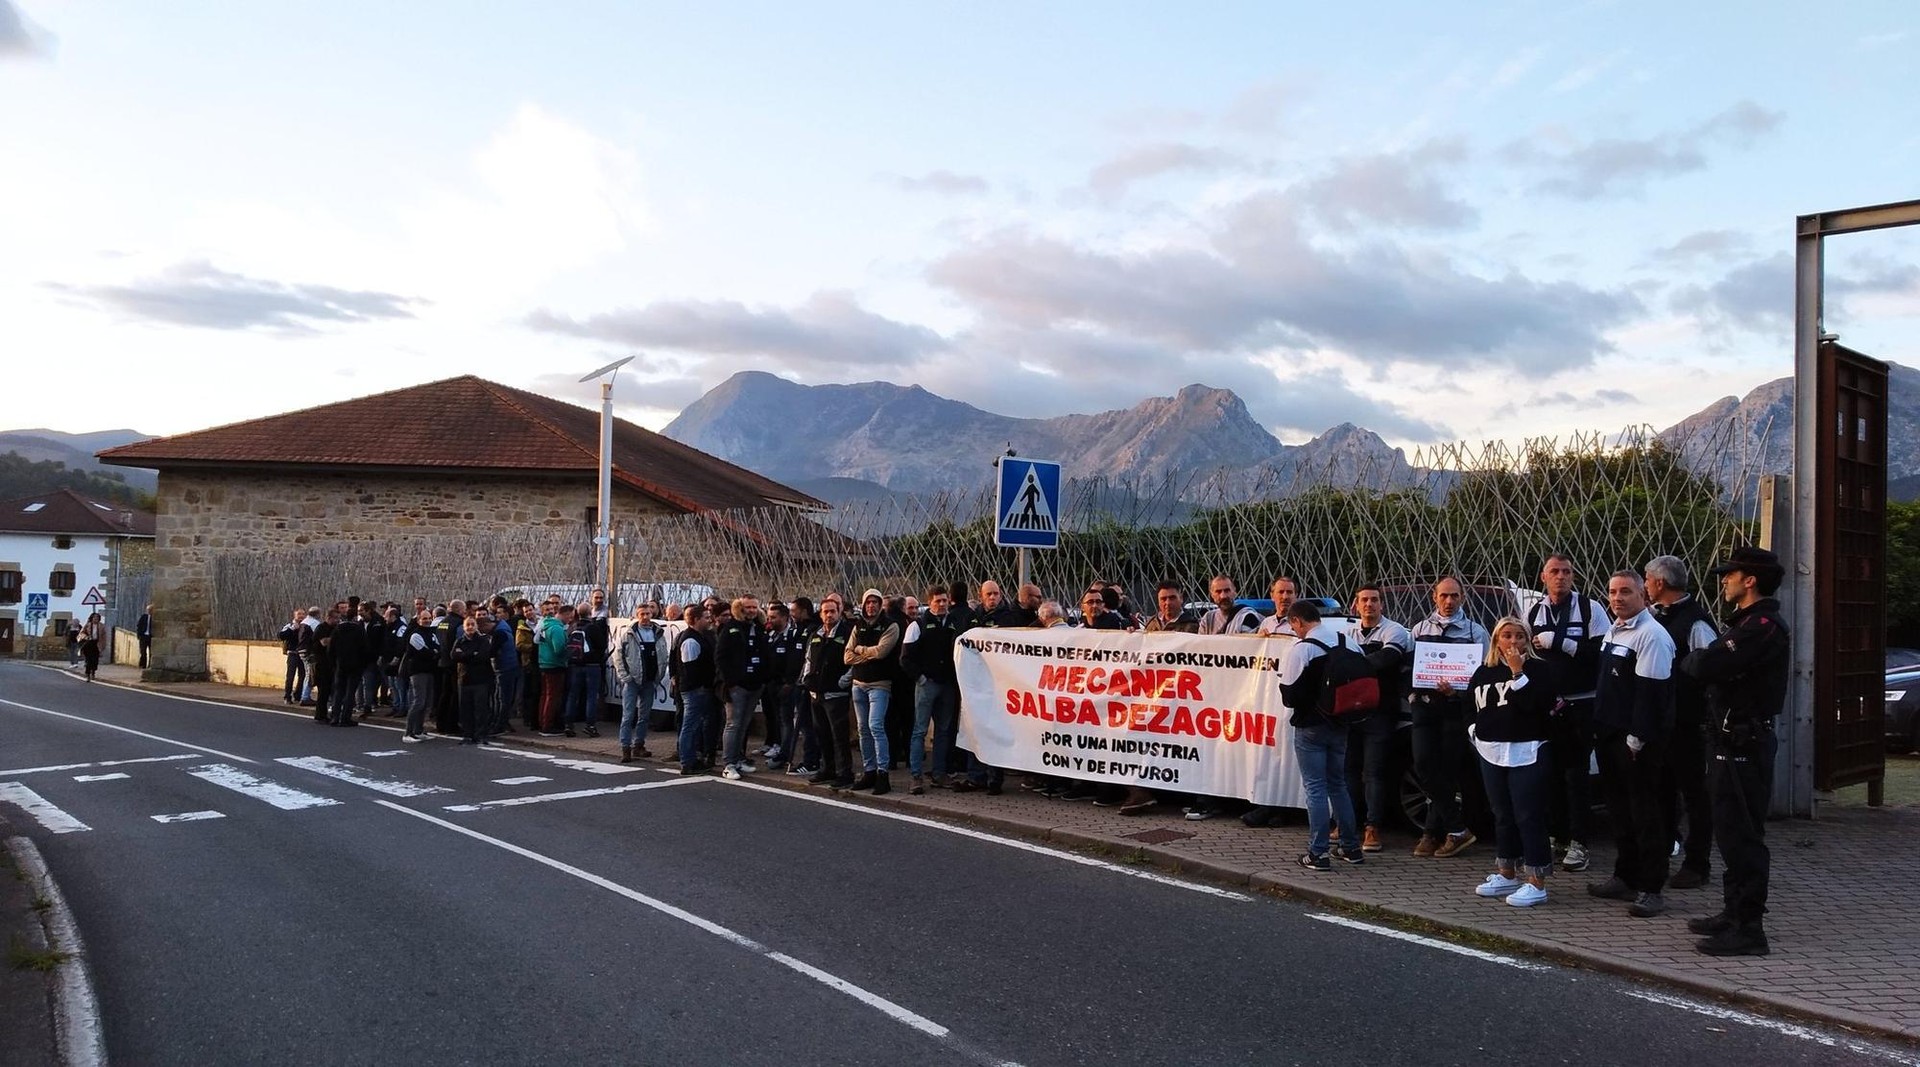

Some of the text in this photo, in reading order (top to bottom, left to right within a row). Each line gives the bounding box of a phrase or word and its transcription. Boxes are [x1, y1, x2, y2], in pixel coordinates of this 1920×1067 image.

[958, 638, 1279, 672] NDUSTRIAREN DEFENTSAN, ETORKIZUNAREN
[1038, 664, 1204, 701] MECANER
[1474, 679, 1514, 713] NY
[1006, 689, 1277, 747] SALBA DEZAGUN!
[1041, 731, 1200, 762] ¡POR UNA INDUSTRIA
[1042, 752, 1179, 784] CON Y DE FUTURO!
